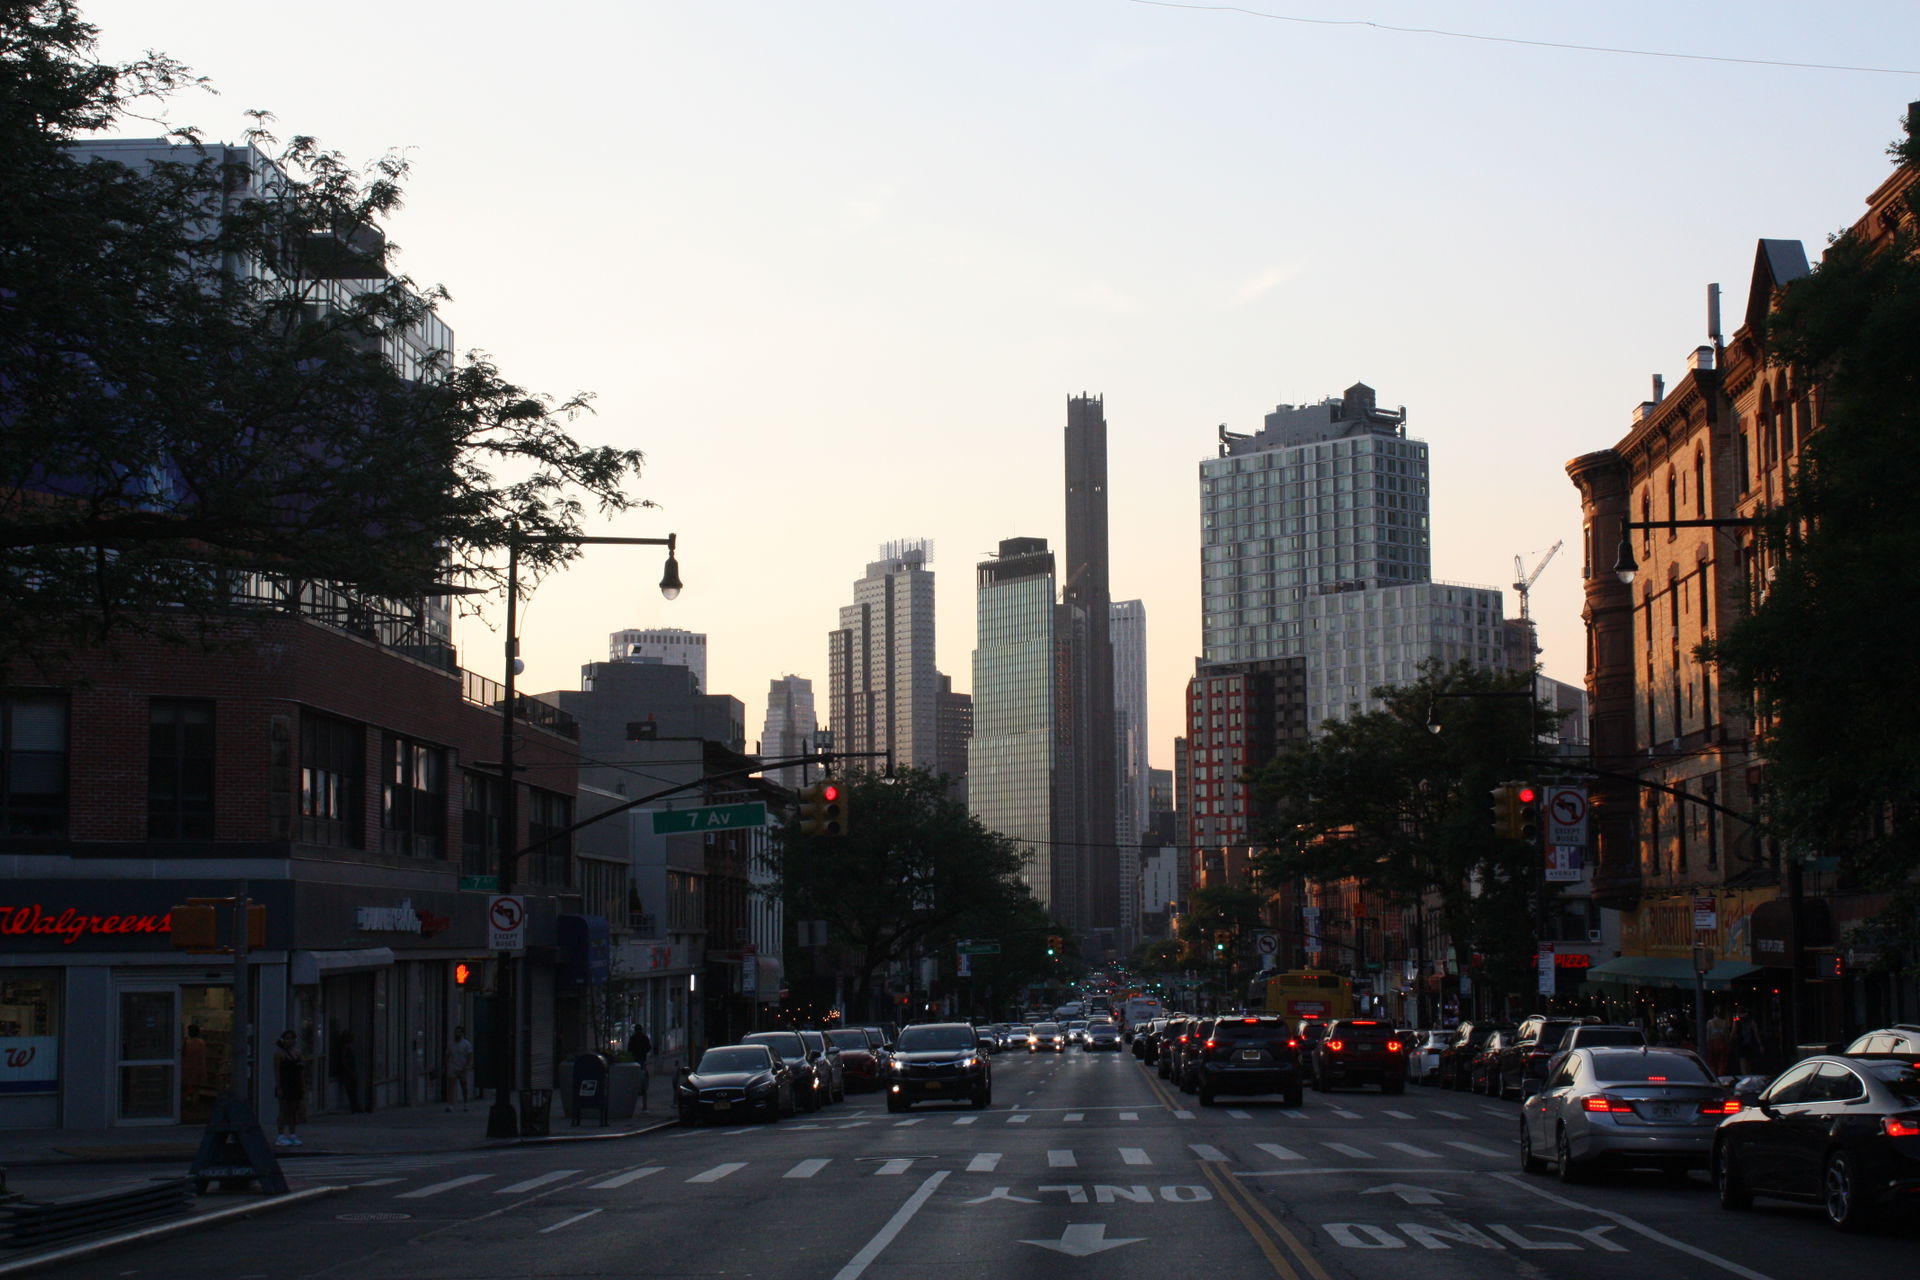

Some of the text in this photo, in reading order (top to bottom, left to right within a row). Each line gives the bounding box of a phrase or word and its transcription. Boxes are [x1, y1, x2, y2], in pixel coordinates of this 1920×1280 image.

[686, 811, 731, 827] 7 Av
[474, 877, 480, 889] 7
[0, 903, 173, 944] Walgreens
[965, 1185, 1213, 1204] ONLY
[1321, 1223, 1631, 1252] ONLY
